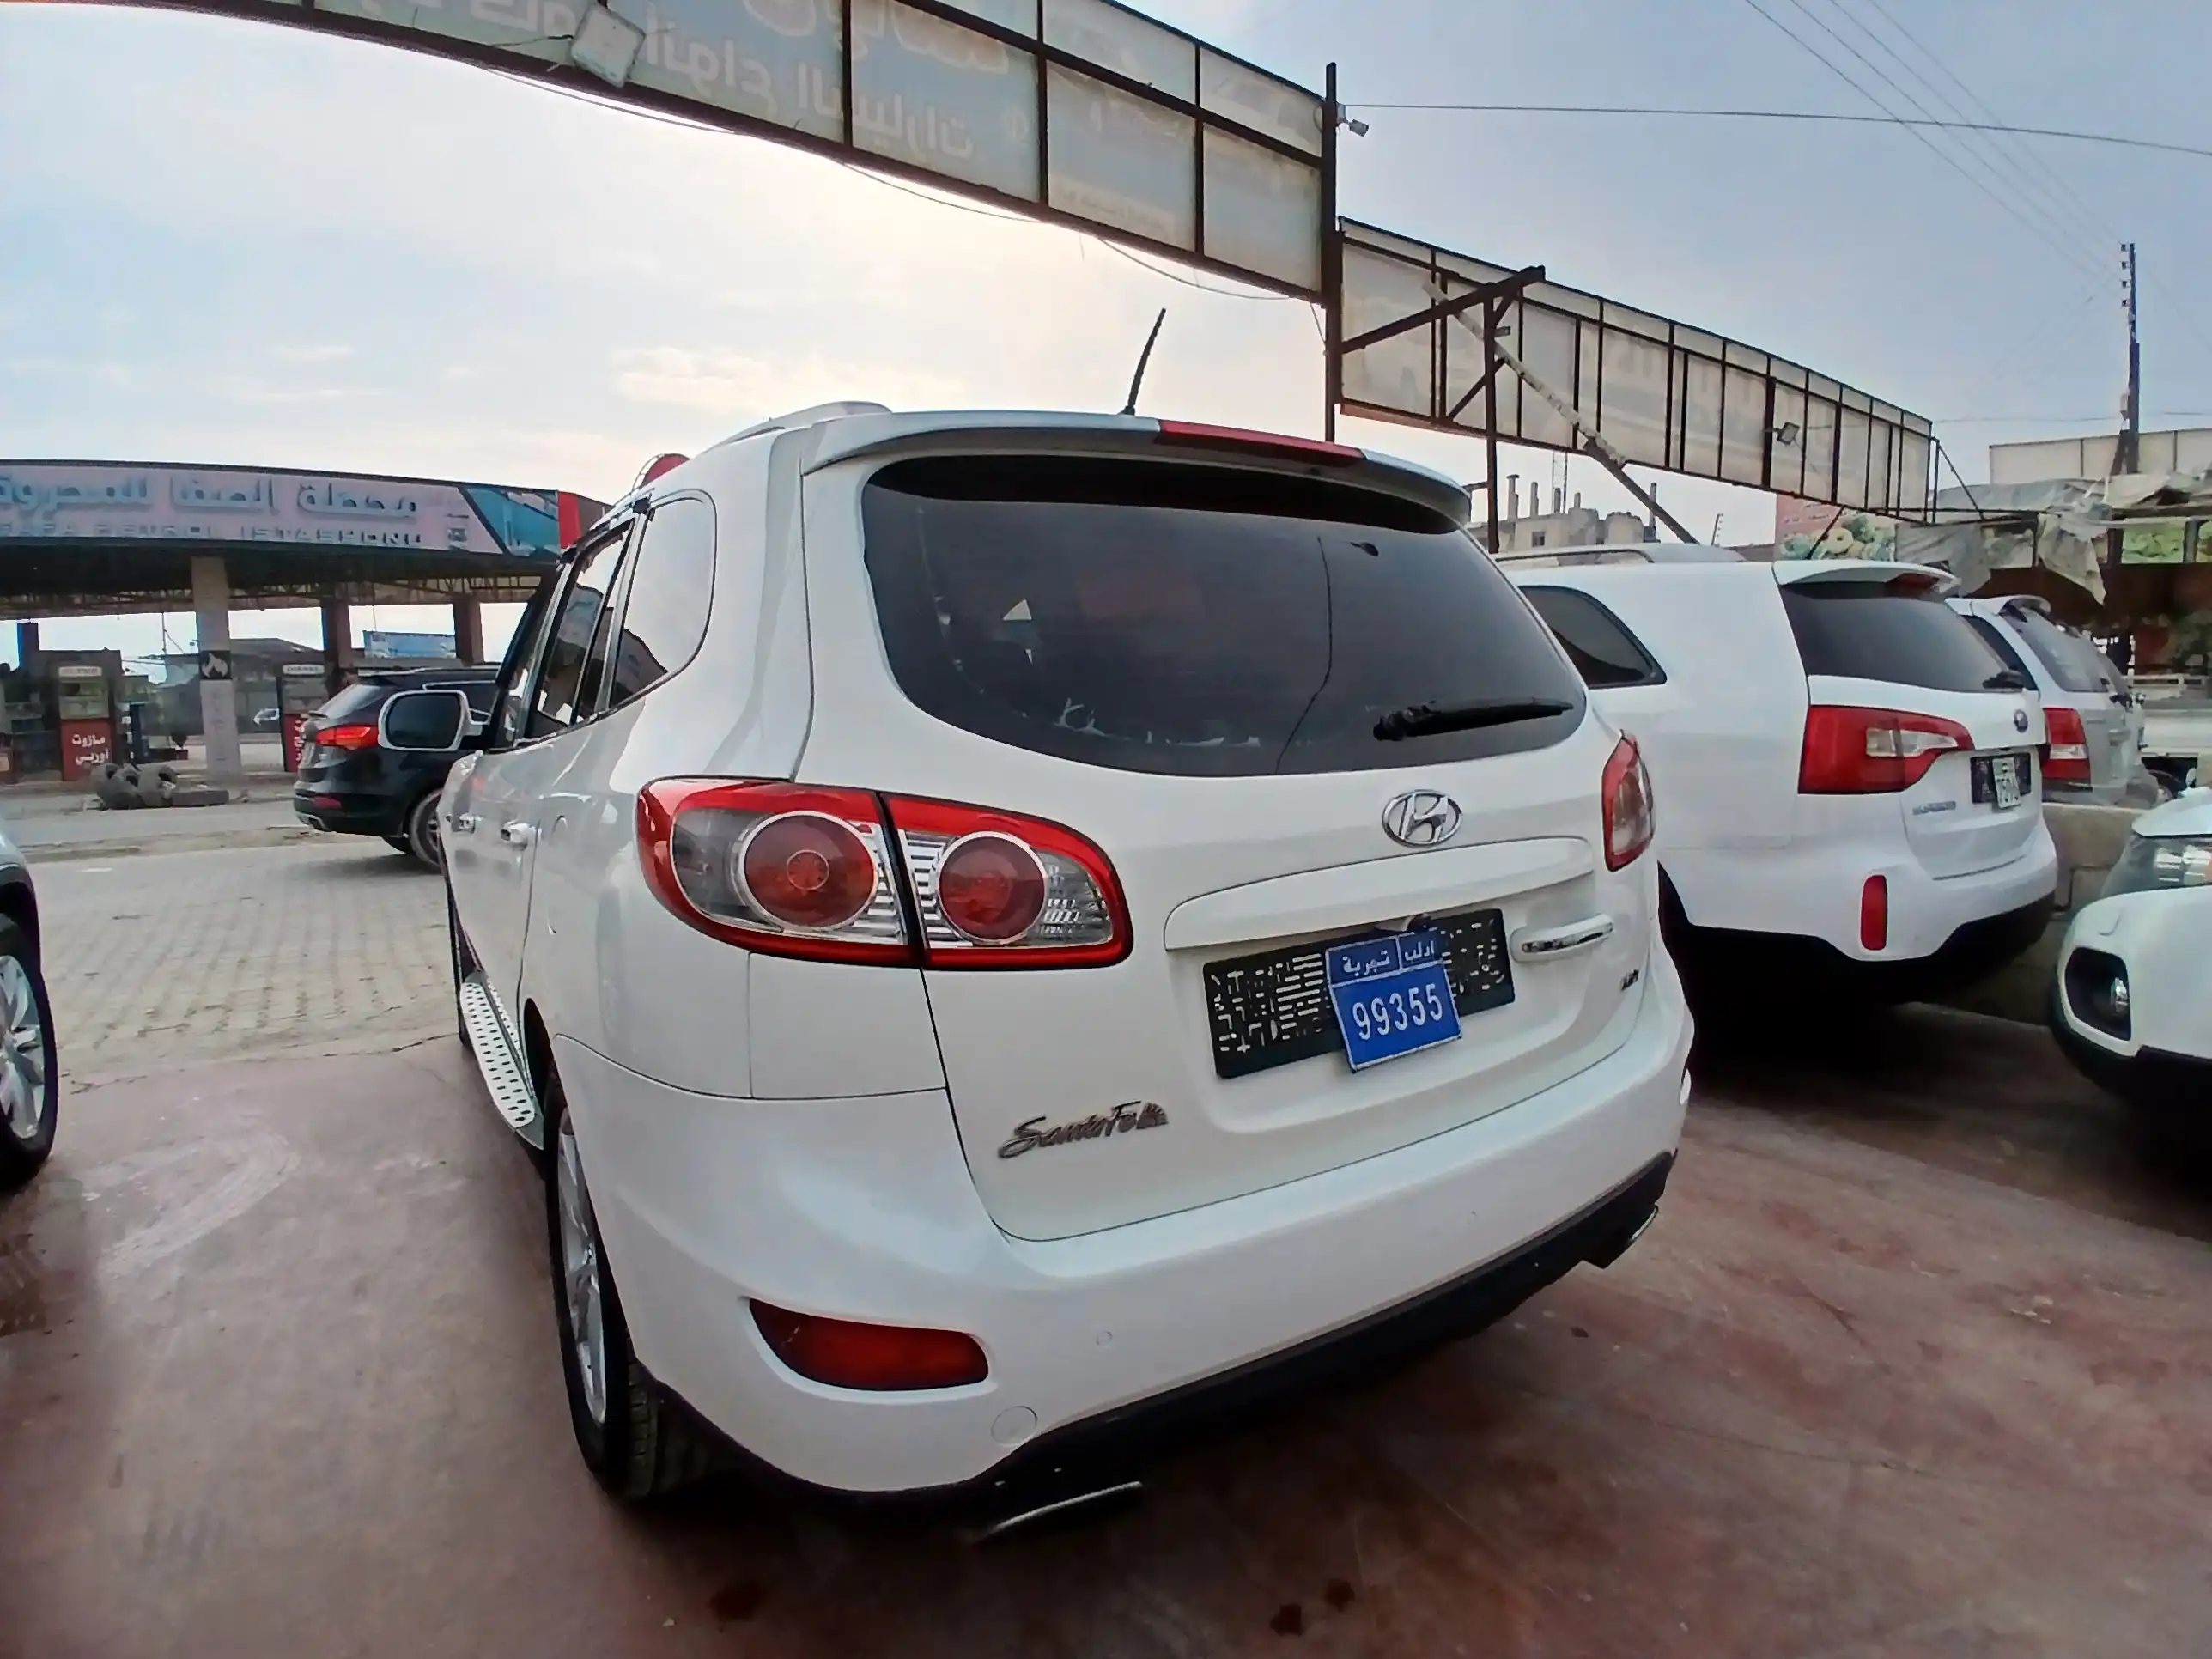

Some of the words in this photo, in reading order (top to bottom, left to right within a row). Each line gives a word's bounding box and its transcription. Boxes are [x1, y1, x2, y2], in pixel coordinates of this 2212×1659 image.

[297, 482, 419, 520] محطة
[71, 733, 106, 748] مازوت
[1342, 950, 1390, 976] تجربة
[1352, 983, 1443, 1041] 99355
